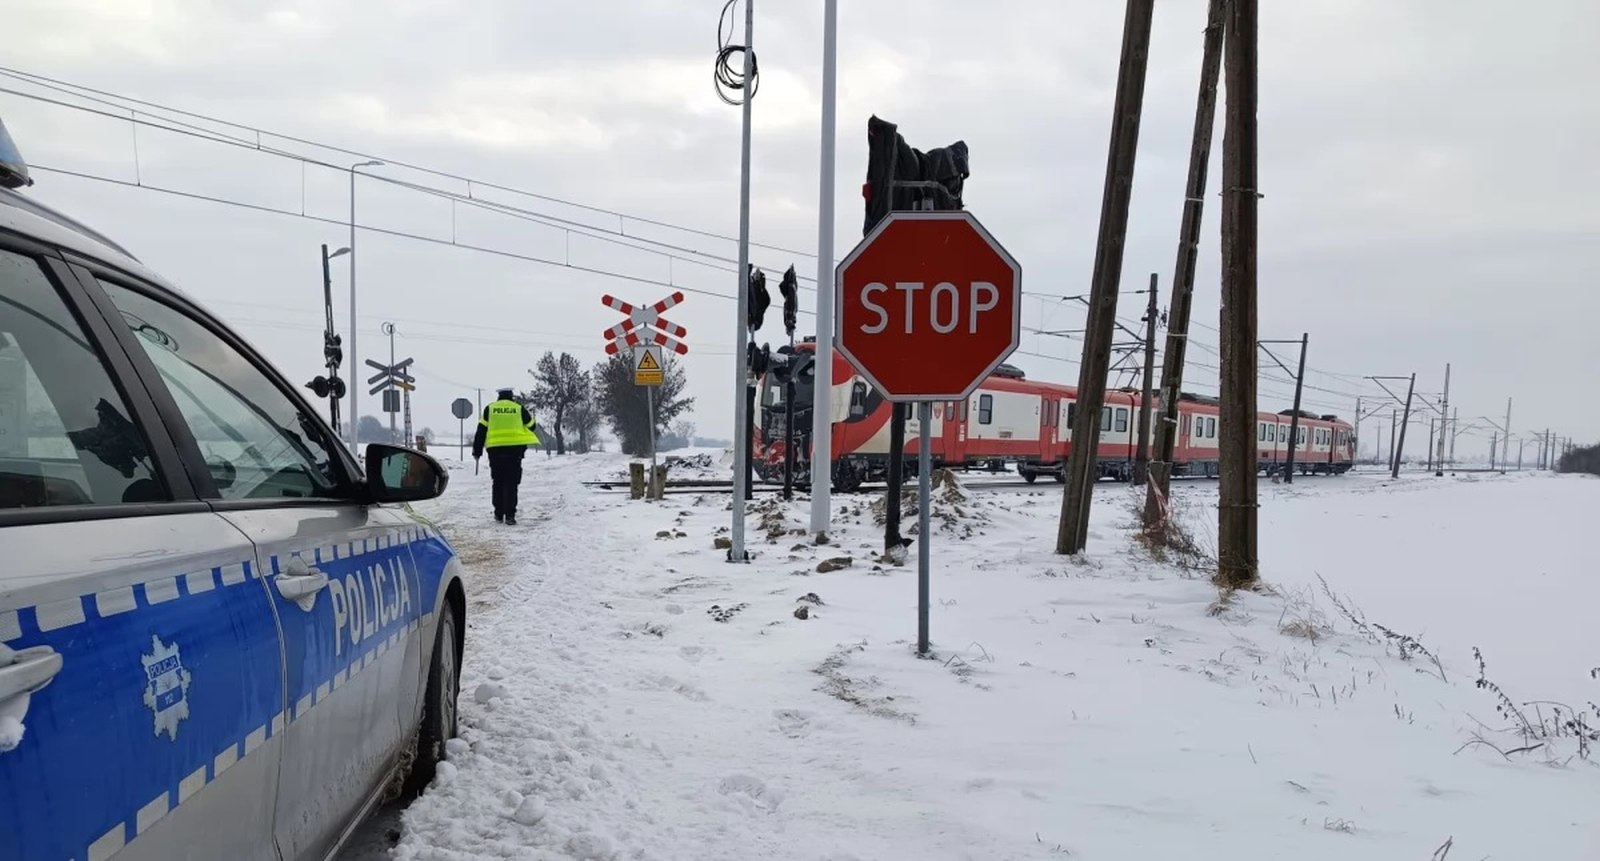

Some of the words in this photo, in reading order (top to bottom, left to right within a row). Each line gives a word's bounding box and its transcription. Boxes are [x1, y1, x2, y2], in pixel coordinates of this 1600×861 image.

[860, 282, 999, 334] STOP
[330, 556, 411, 655] POLICJA
[150, 656, 178, 677] POLICJA
